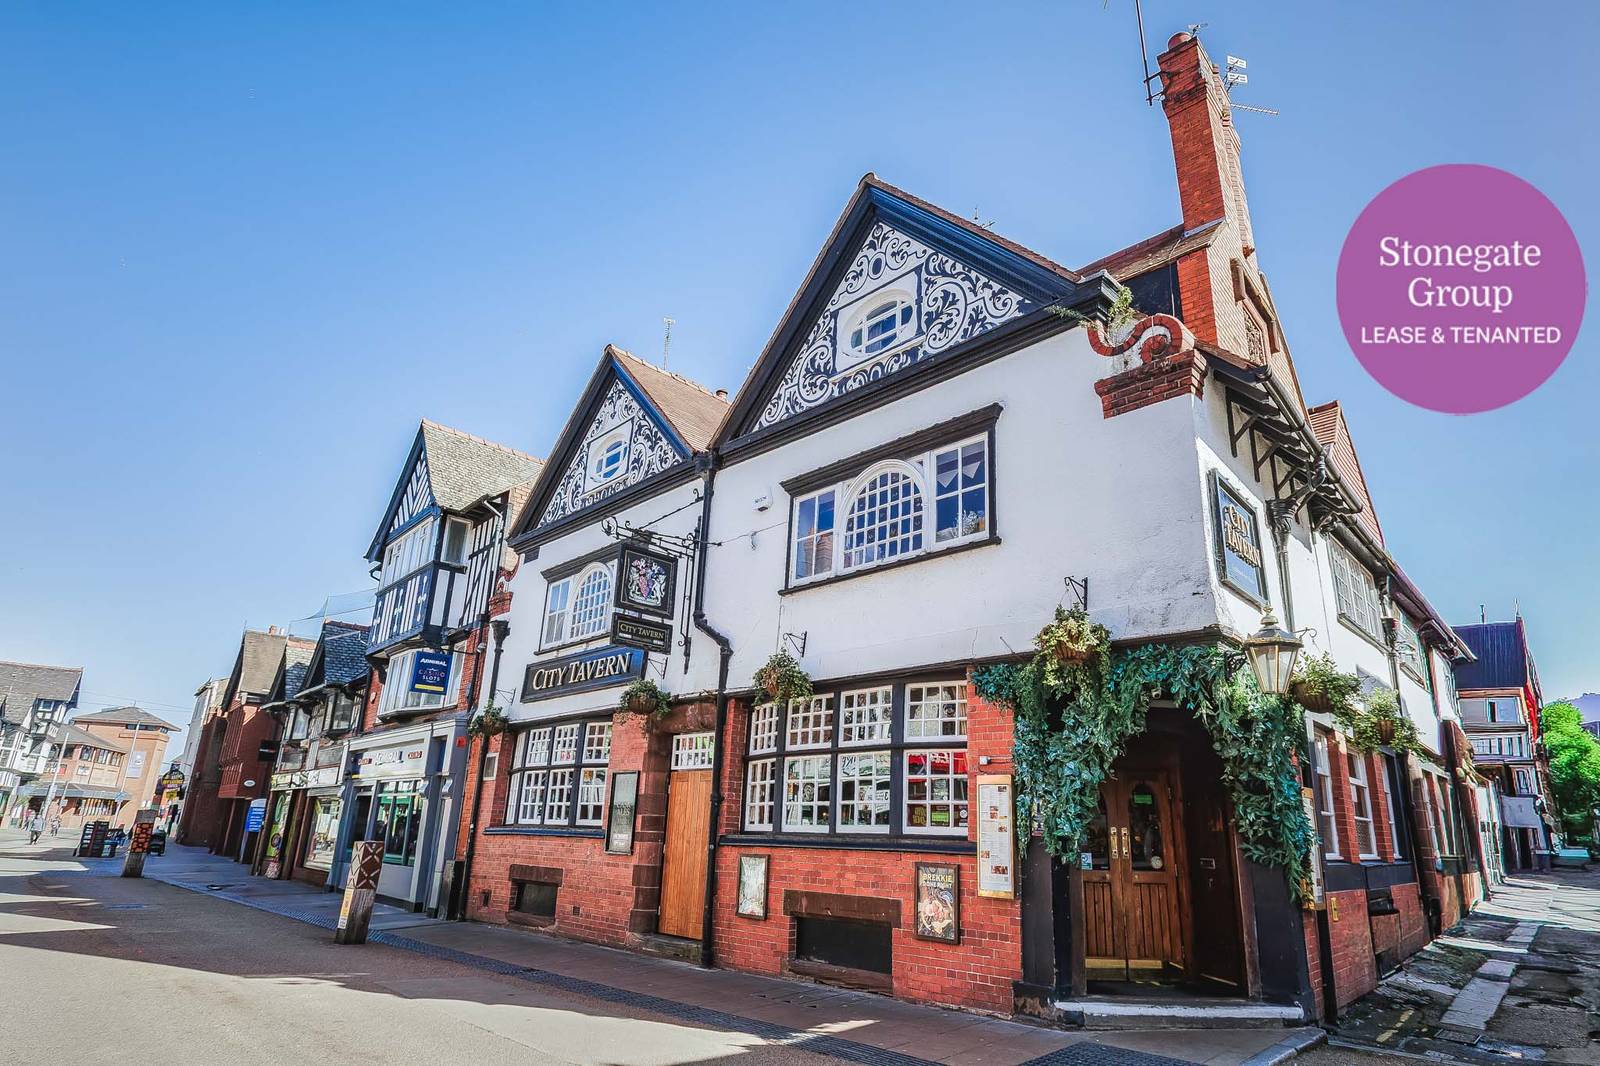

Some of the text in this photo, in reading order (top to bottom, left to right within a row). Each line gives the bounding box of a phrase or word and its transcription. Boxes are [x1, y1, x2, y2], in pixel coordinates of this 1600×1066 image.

[620, 624, 665, 639] CITY TAVERN
[533, 652, 631, 690] CITY TAVERN
